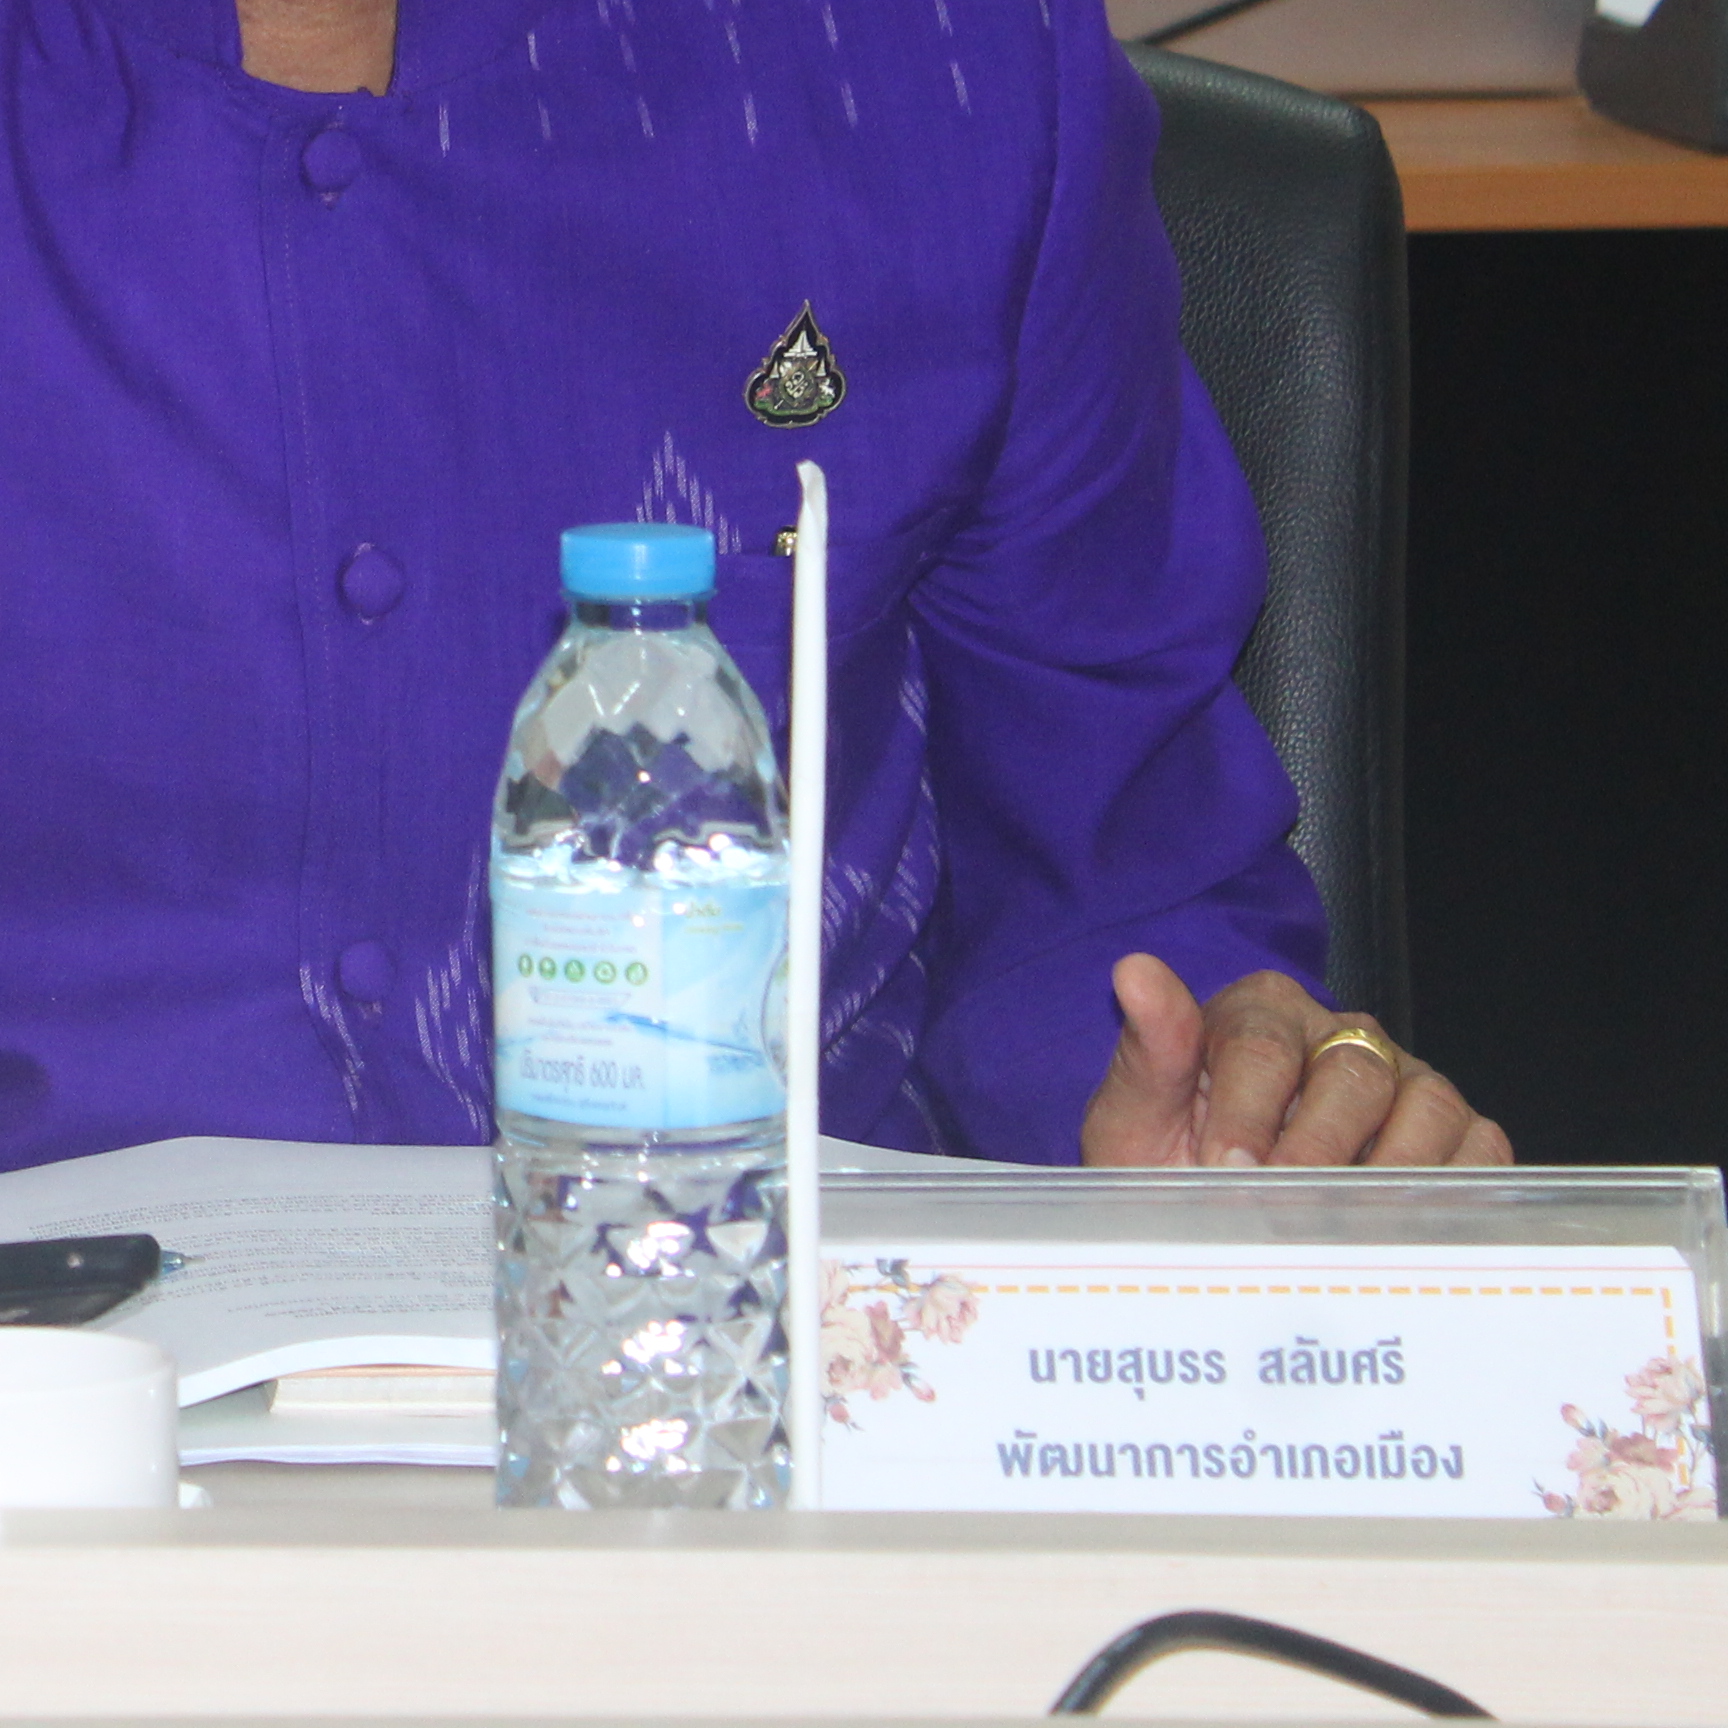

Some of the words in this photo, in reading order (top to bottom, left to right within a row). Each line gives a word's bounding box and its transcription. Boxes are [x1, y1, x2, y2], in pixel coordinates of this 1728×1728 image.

[1257, 1336, 1407, 1386] สลับศรี
[995, 1427, 1465, 1481] พัฒนาการอำเภอเมือง
